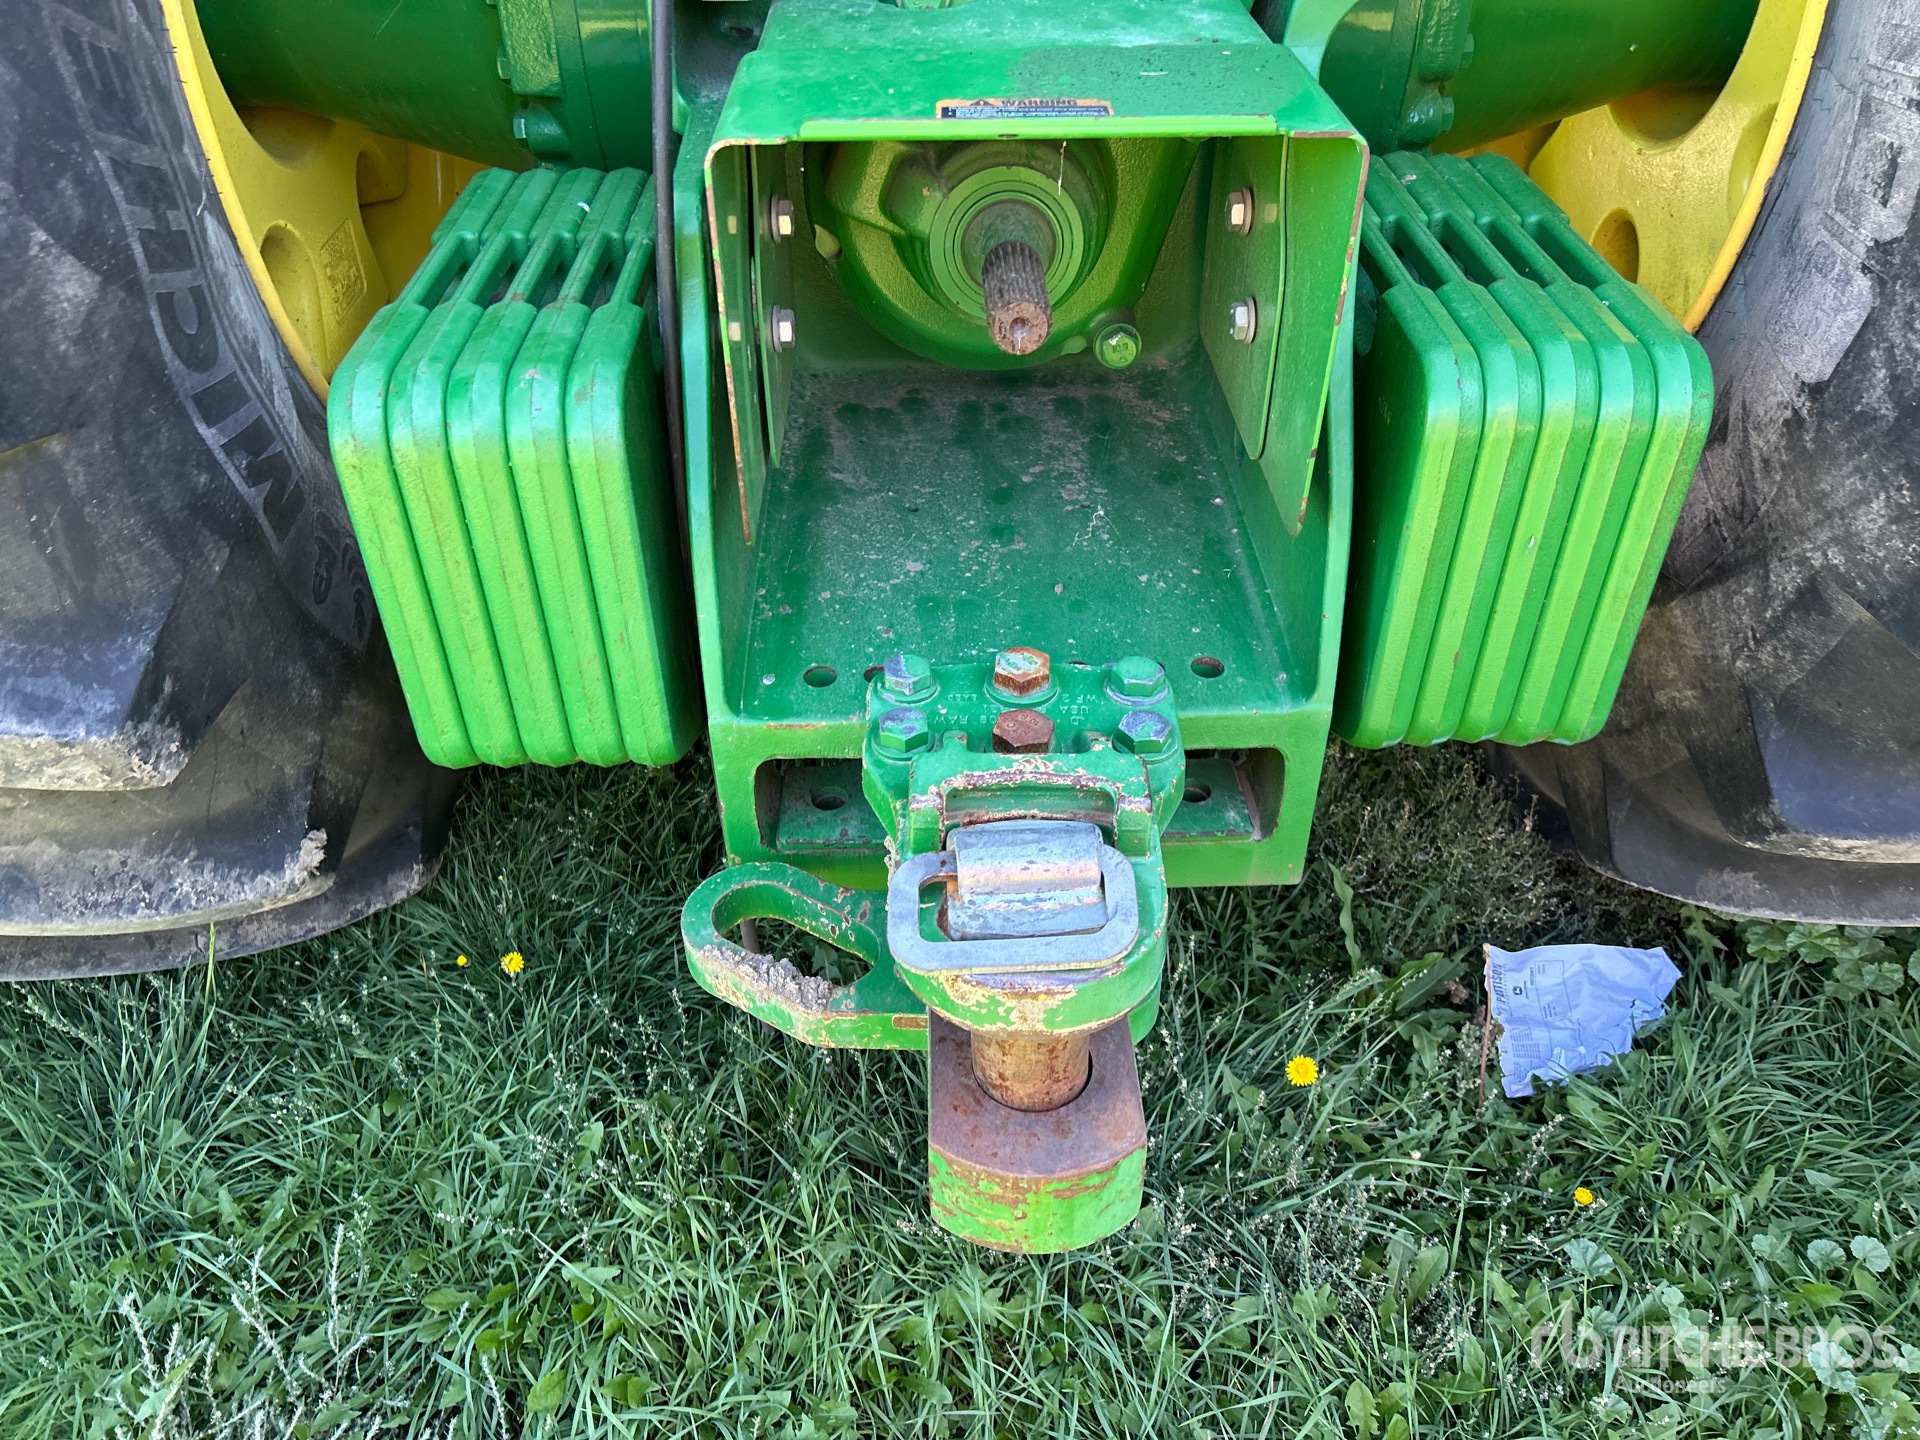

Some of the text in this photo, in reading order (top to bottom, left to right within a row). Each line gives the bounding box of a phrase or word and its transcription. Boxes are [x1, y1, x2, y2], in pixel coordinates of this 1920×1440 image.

[1002, 99, 1078, 107] WARNING
[59, 0, 301, 544] MICHE
[1058, 704, 1090, 715] USA
[1492, 961, 1505, 1004] PATTISON
